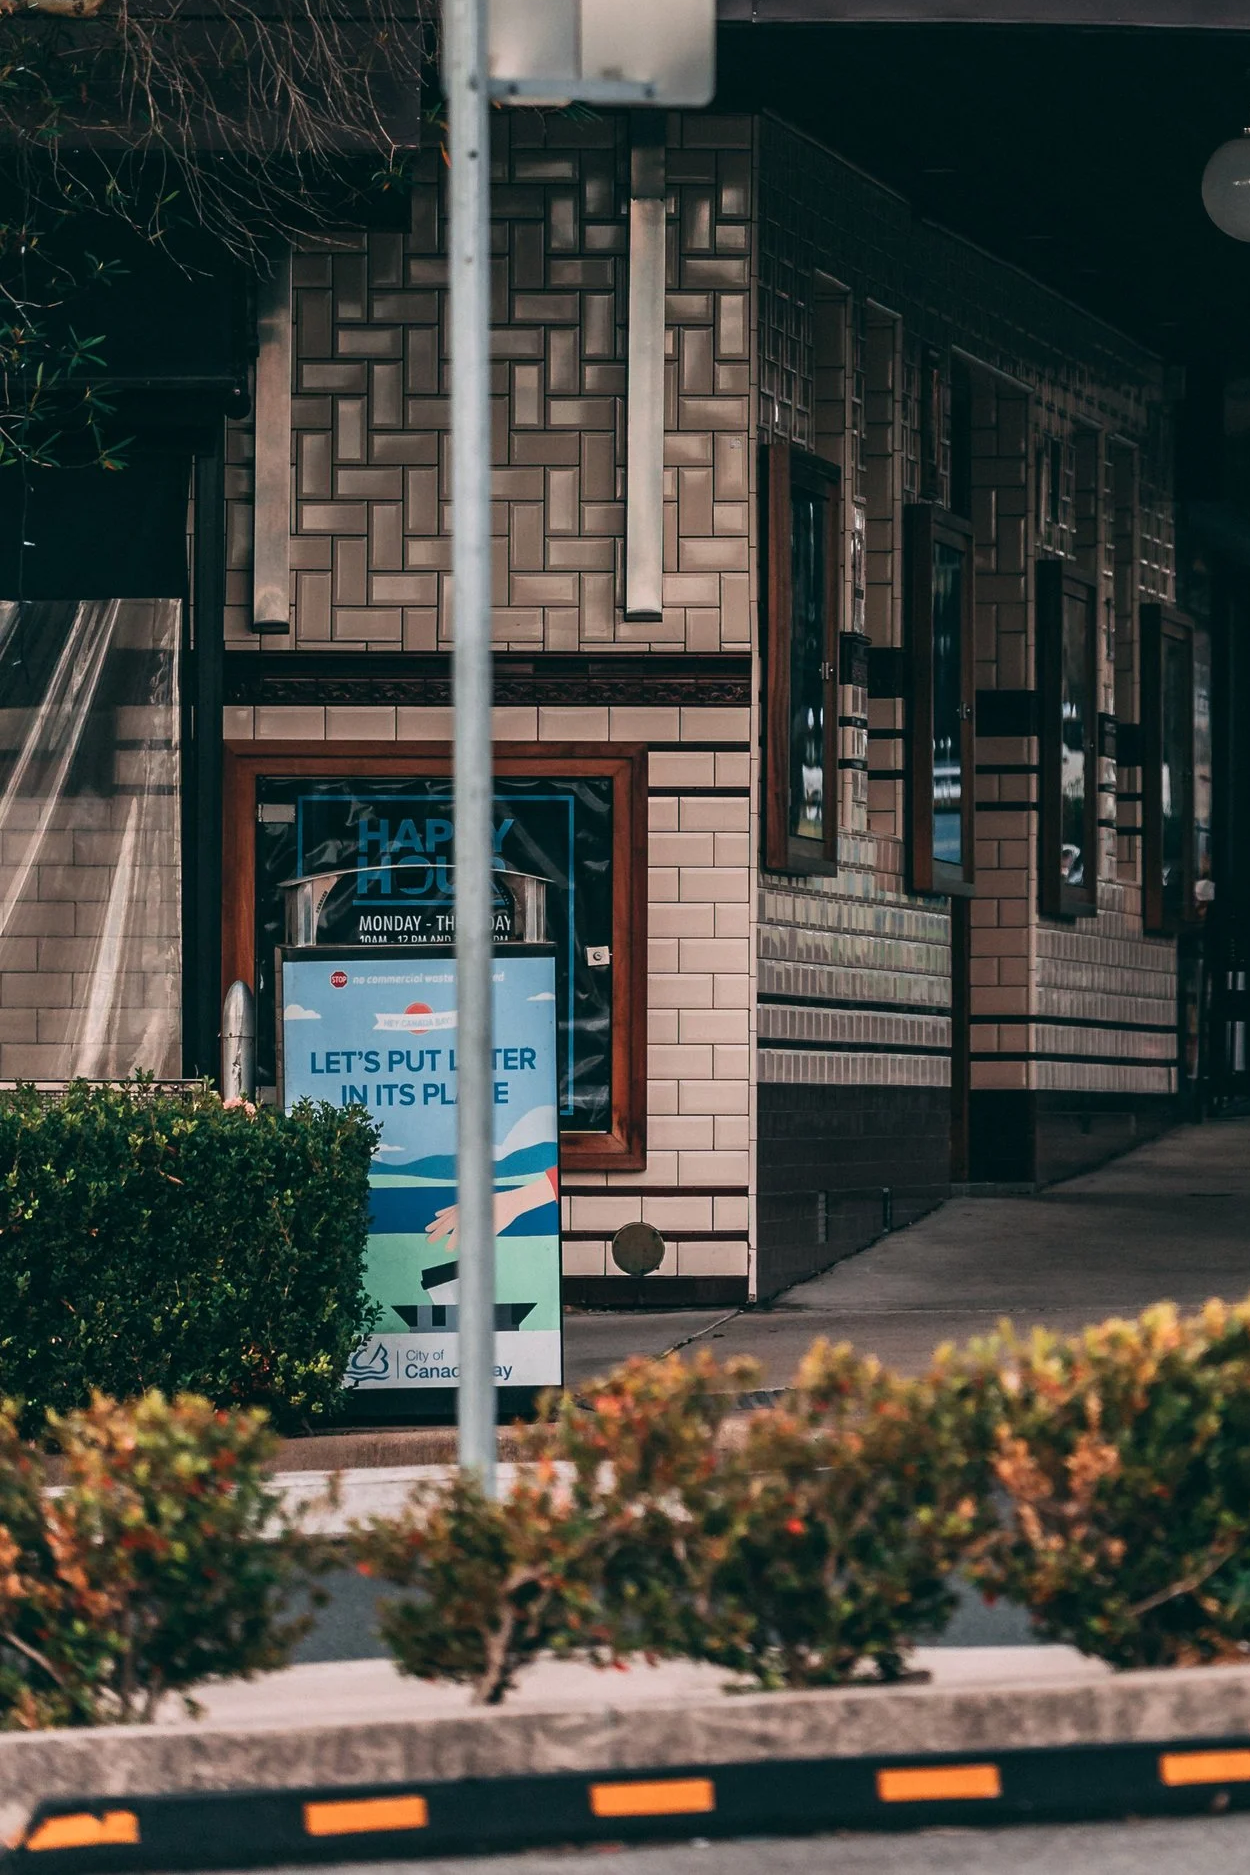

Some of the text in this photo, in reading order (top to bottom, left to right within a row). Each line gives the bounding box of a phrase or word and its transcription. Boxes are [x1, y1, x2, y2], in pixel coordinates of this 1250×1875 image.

[358, 818, 515, 853] HAPY
[359, 915, 422, 932] MONDAY
[330, 973, 454, 985] STOP no commercial waste
[310, 1046, 537, 1074] LET’S PUT LTER
[342, 1082, 509, 1107] IN ITS PLE
[406, 1349, 444, 1363] City of
